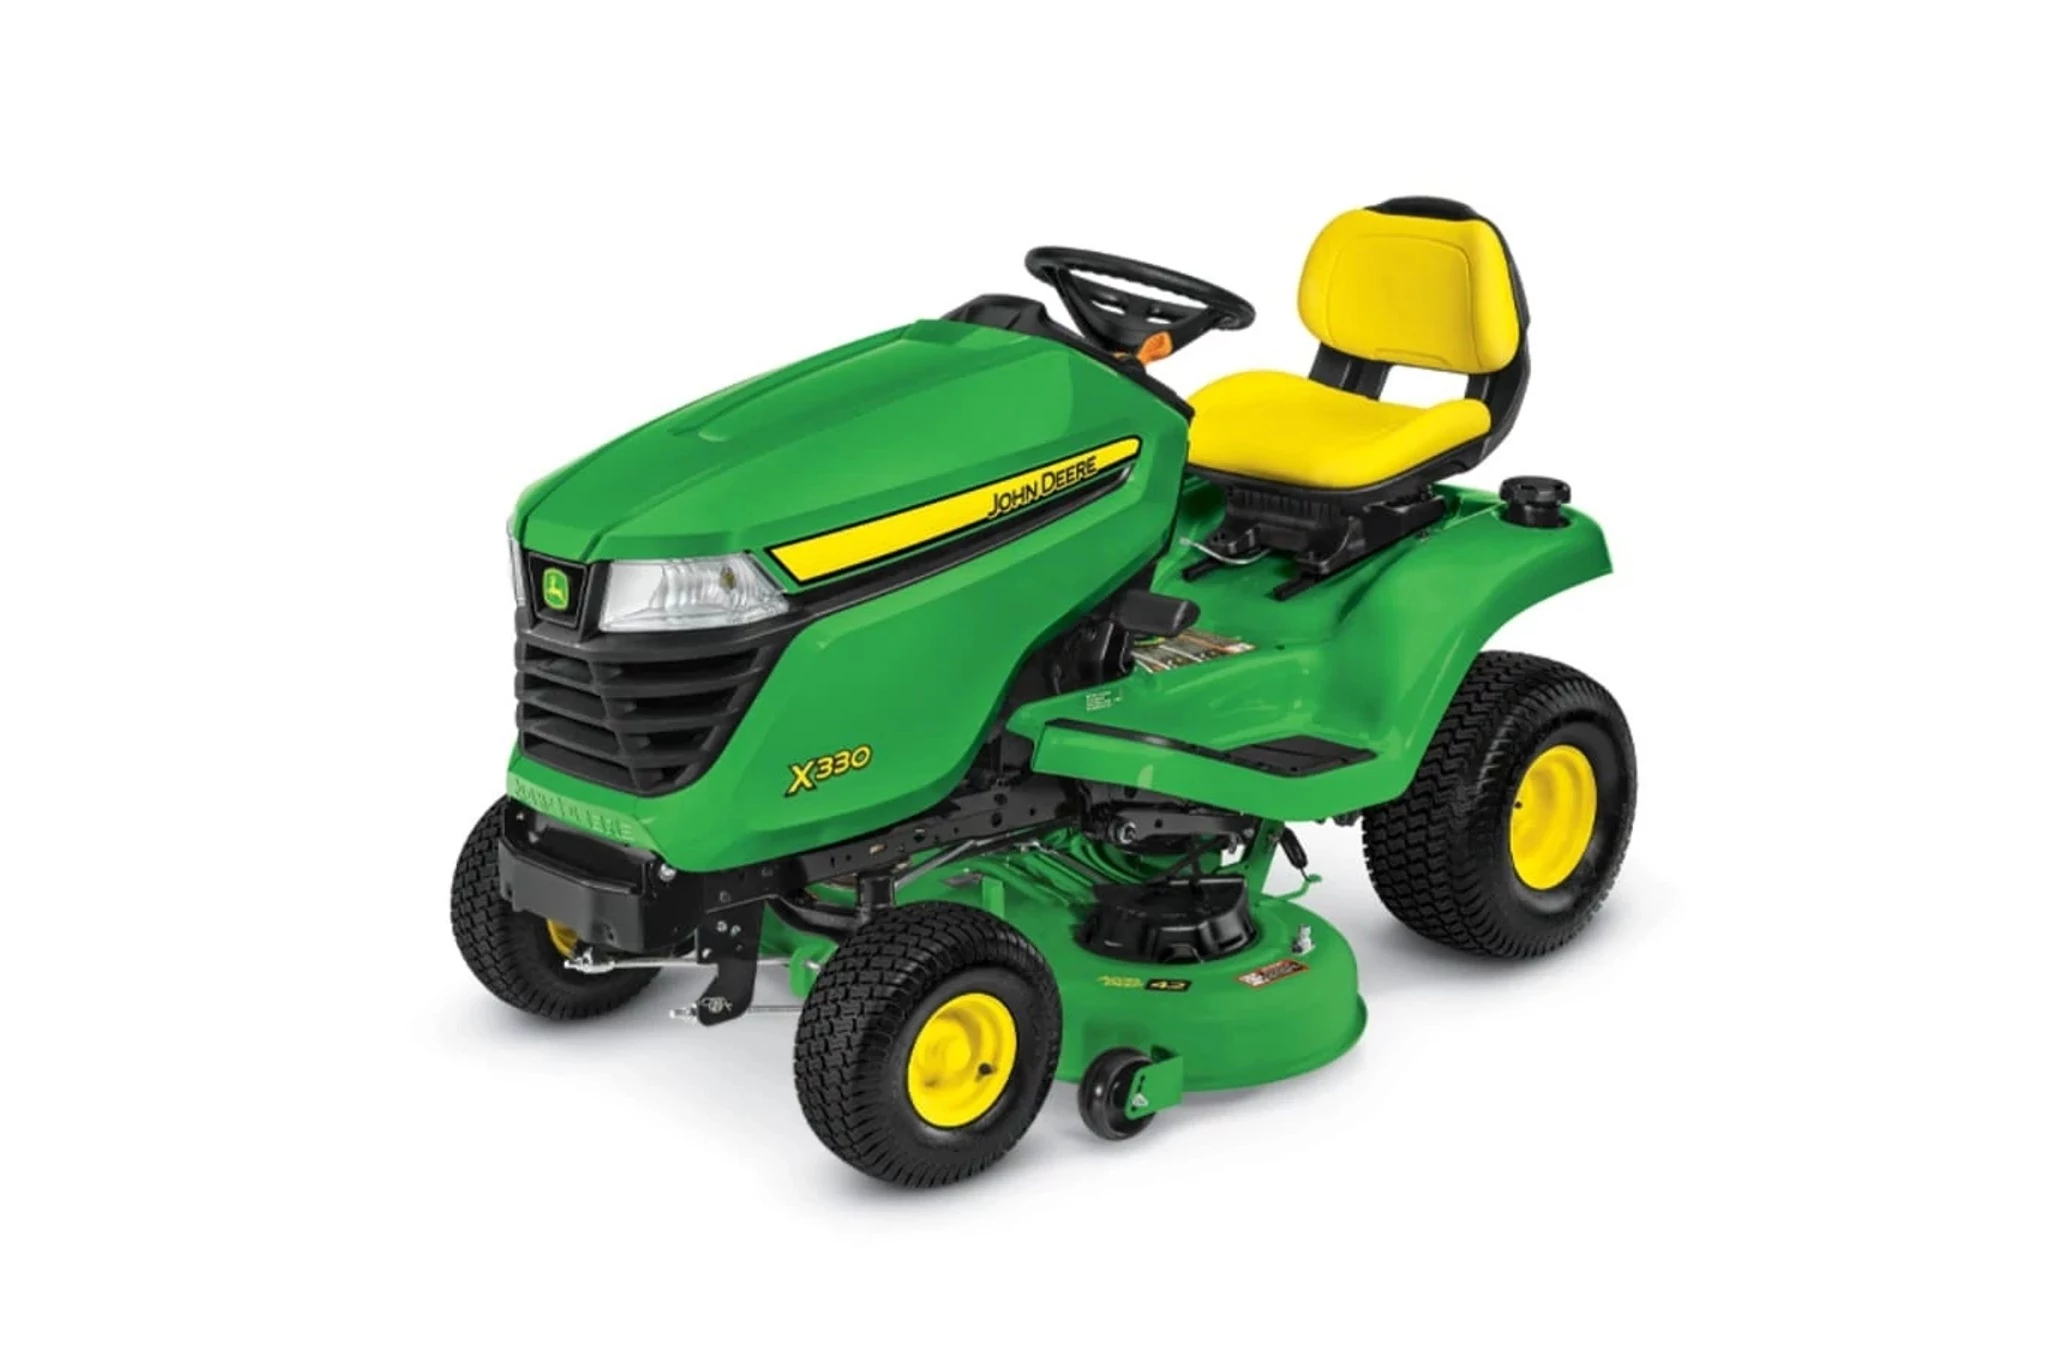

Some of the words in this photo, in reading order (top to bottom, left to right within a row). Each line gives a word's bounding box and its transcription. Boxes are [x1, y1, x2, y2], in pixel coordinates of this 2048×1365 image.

[988, 479, 1038, 517] JOHN
[1041, 455, 1097, 494] DEERE
[784, 744, 872, 798] X330
